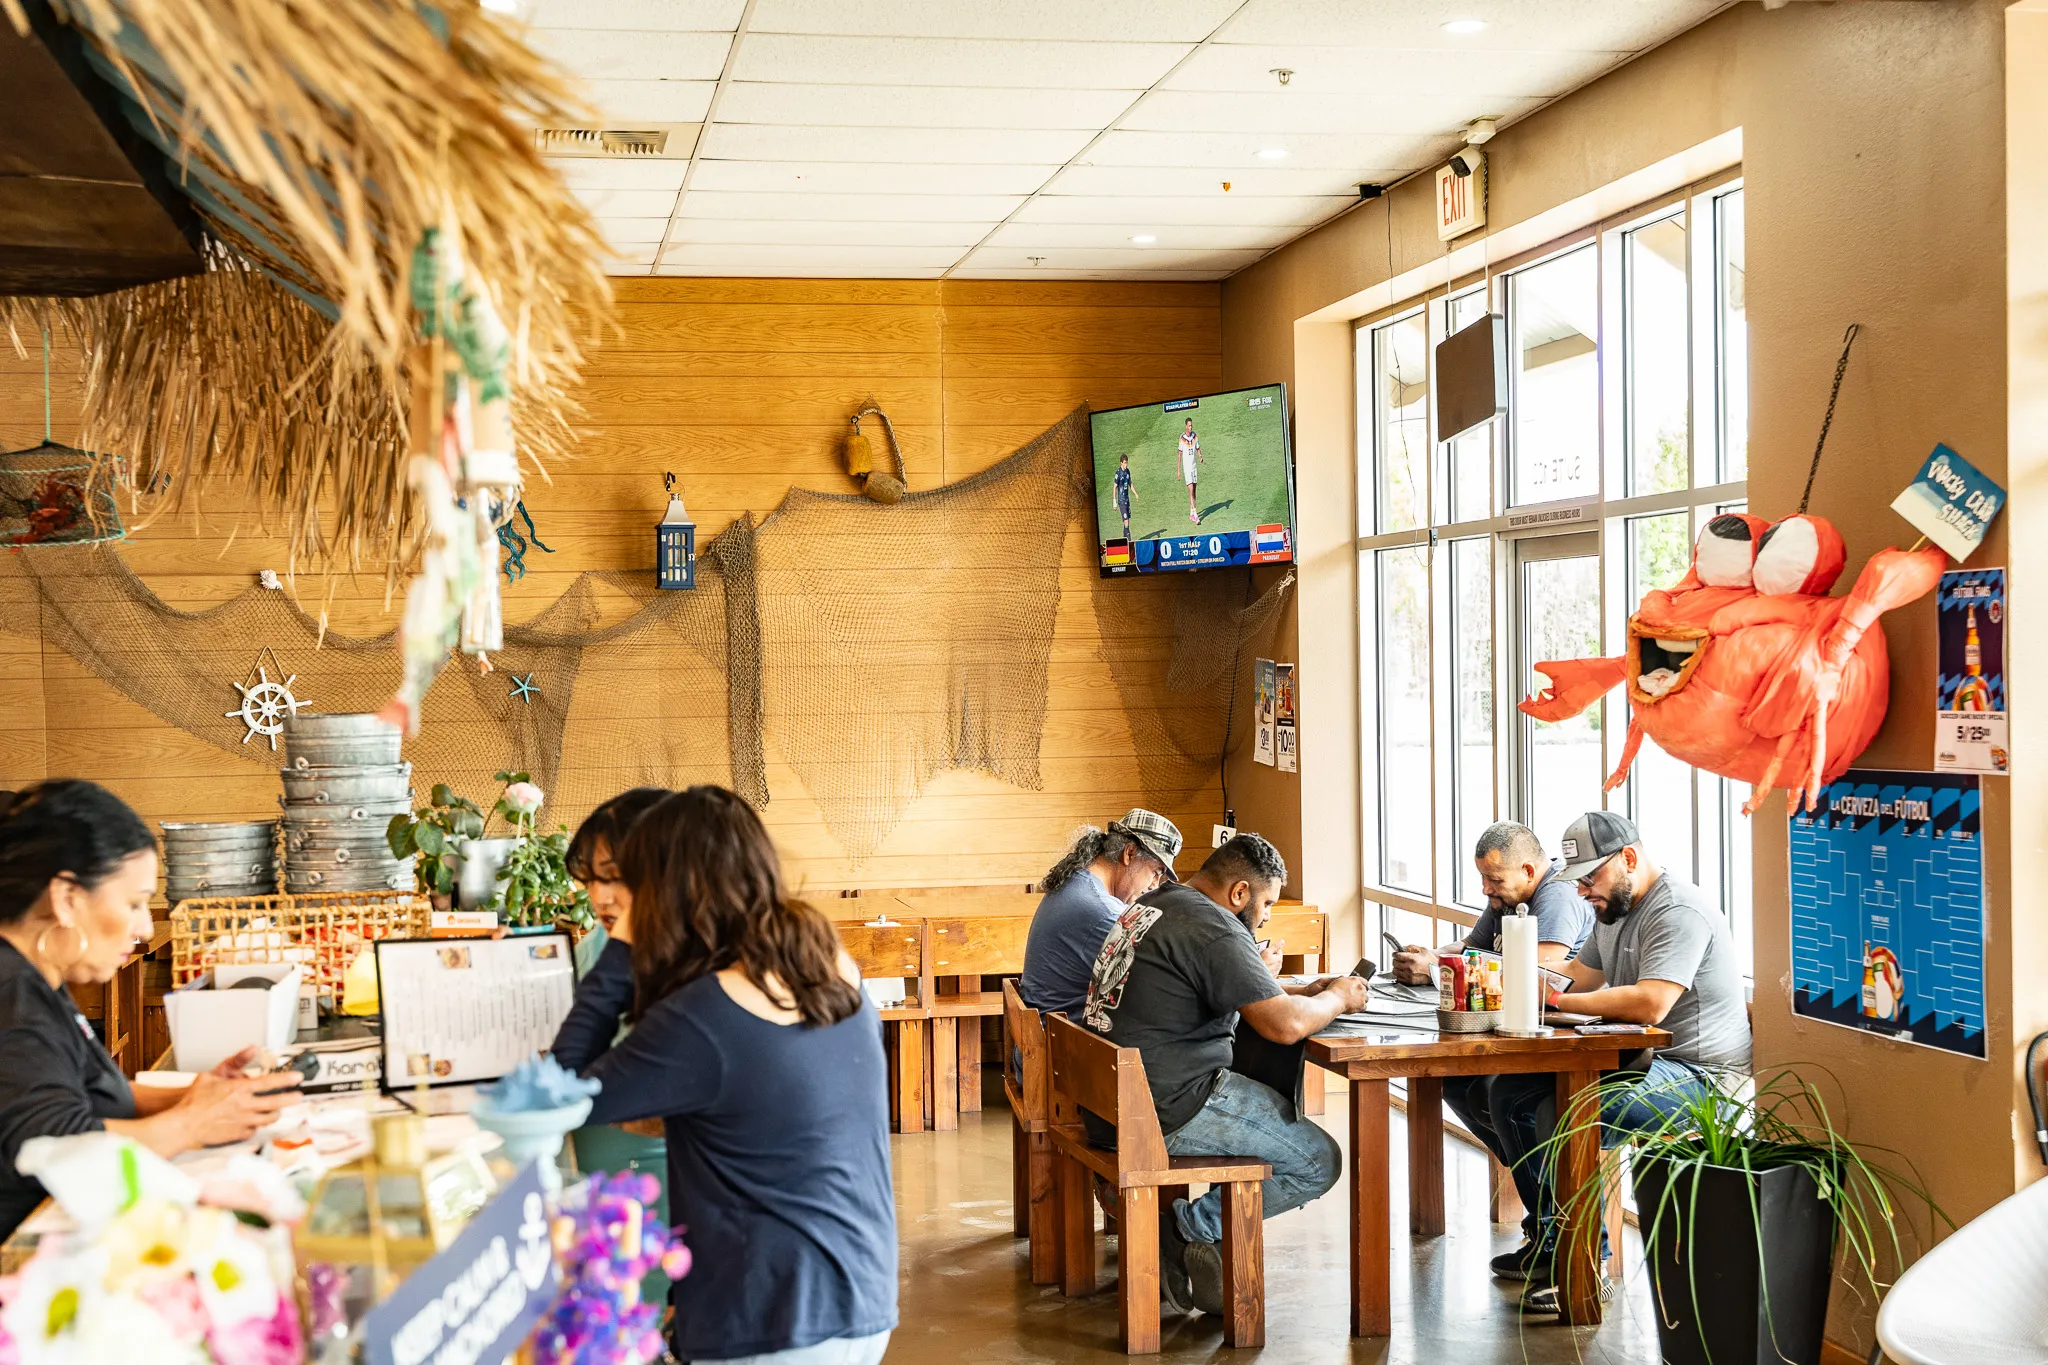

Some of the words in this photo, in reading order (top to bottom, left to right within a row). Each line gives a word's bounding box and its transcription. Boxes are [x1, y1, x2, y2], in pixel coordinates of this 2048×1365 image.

[1160, 541, 1172, 559] 0
[1188, 540, 1201, 548] HALF
[1209, 536, 1222, 555] 0
[1182, 549, 1199, 557] 17:20
[1831, 799, 1840, 811] LA
[1840, 795, 1880, 818] CERVEZA
[1880, 803, 1895, 816] DEL
[1894, 794, 1931, 822] FÚTBOL
[1220, 830, 1229, 846] 6
